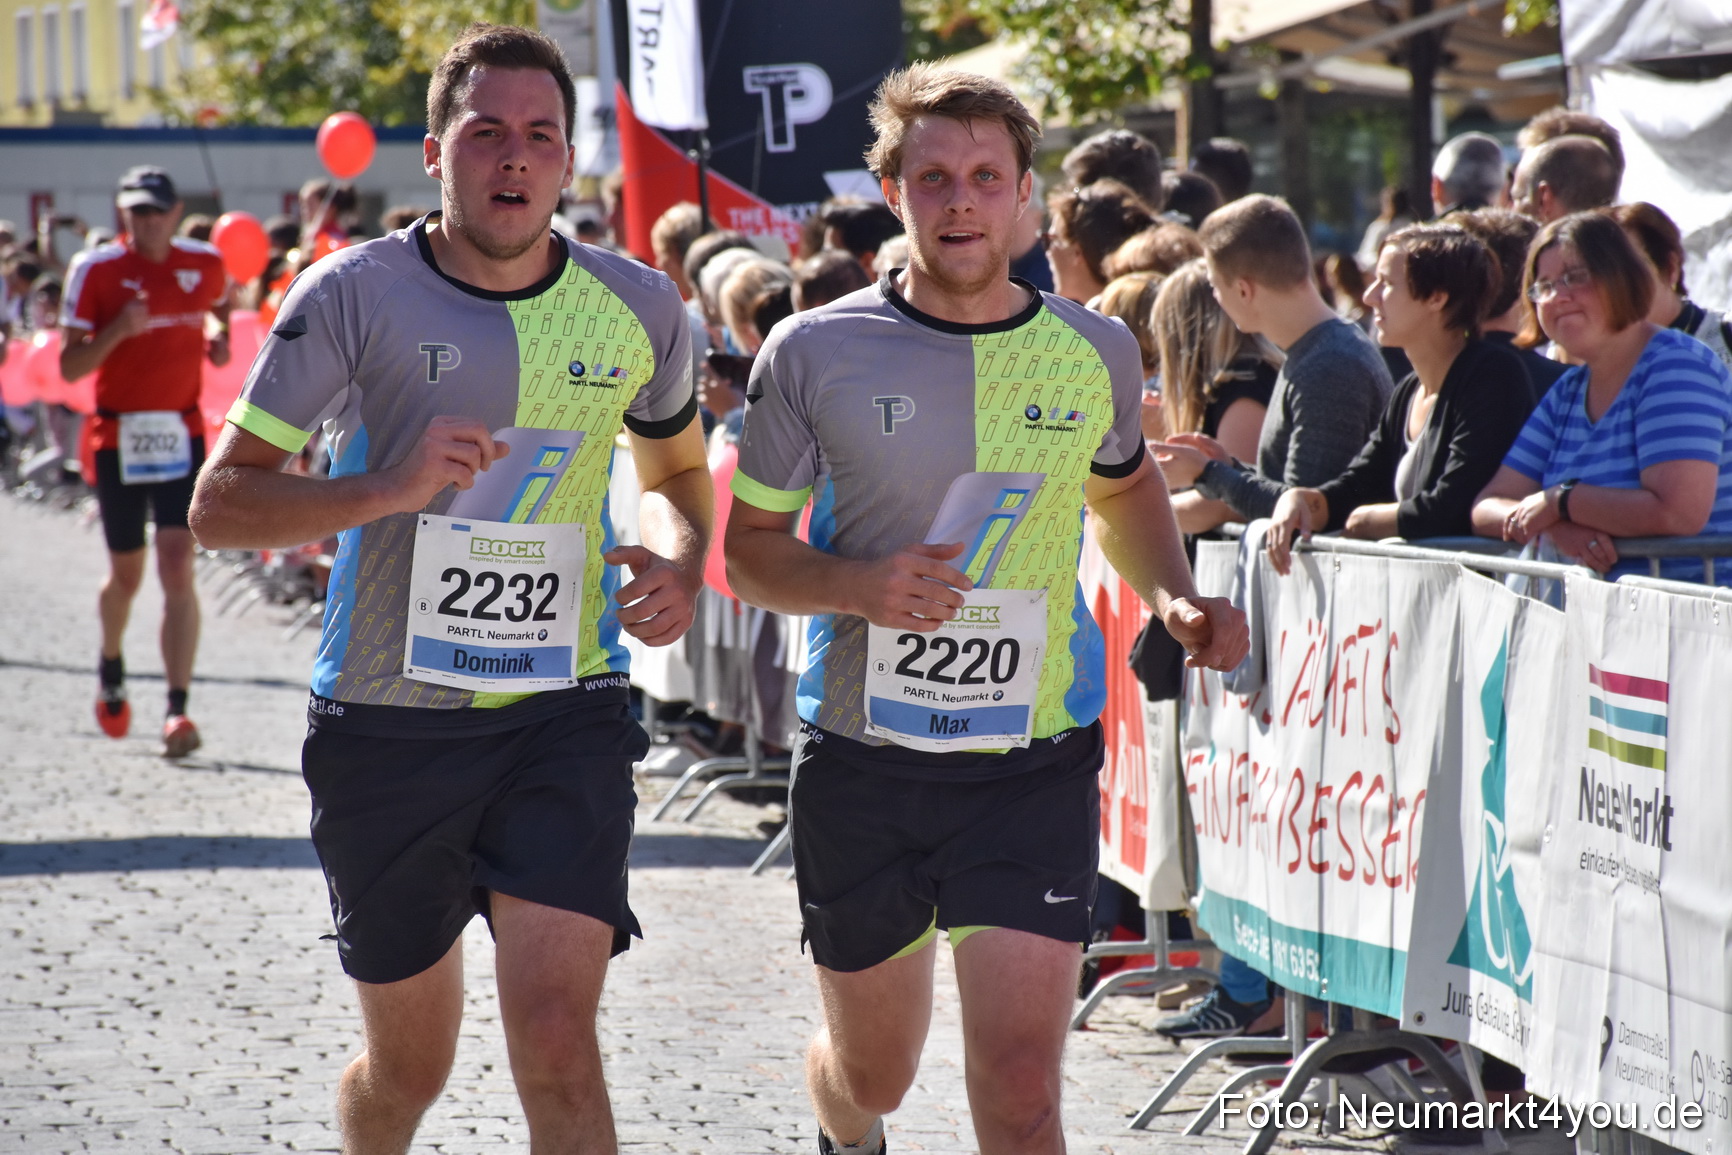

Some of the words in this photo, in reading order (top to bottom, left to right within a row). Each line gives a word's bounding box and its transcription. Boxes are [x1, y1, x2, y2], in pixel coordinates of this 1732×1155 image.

[568, 379, 588, 387] PARTL
[589, 381, 617, 389] NEUMARKT
[1025, 423, 1045, 431] PARTL
[1045, 425, 1077, 433] NEUMARKT
[130, 431, 179, 454] 2202
[470, 537, 546, 558] BOCK
[468, 555, 494, 564] inspired
[494, 556, 503, 565] by
[437, 567, 560, 623] 2232
[420, 601, 427, 611] B
[447, 625, 485, 640] PARTL
[487, 630, 535, 641] Neumarkt
[453, 648, 535, 674] Dominik
[878, 662, 885, 672] B
[895, 633, 1020, 685] 2220
[903, 686, 939, 702] PARTL
[941, 692, 989, 703] Neumarkt
[929, 713, 971, 735] Max
[1578, 766, 1674, 852] NeueMarkt
[1441, 982, 1473, 1018] Jura
[1614, 1055, 1654, 1090] Neumarkt
